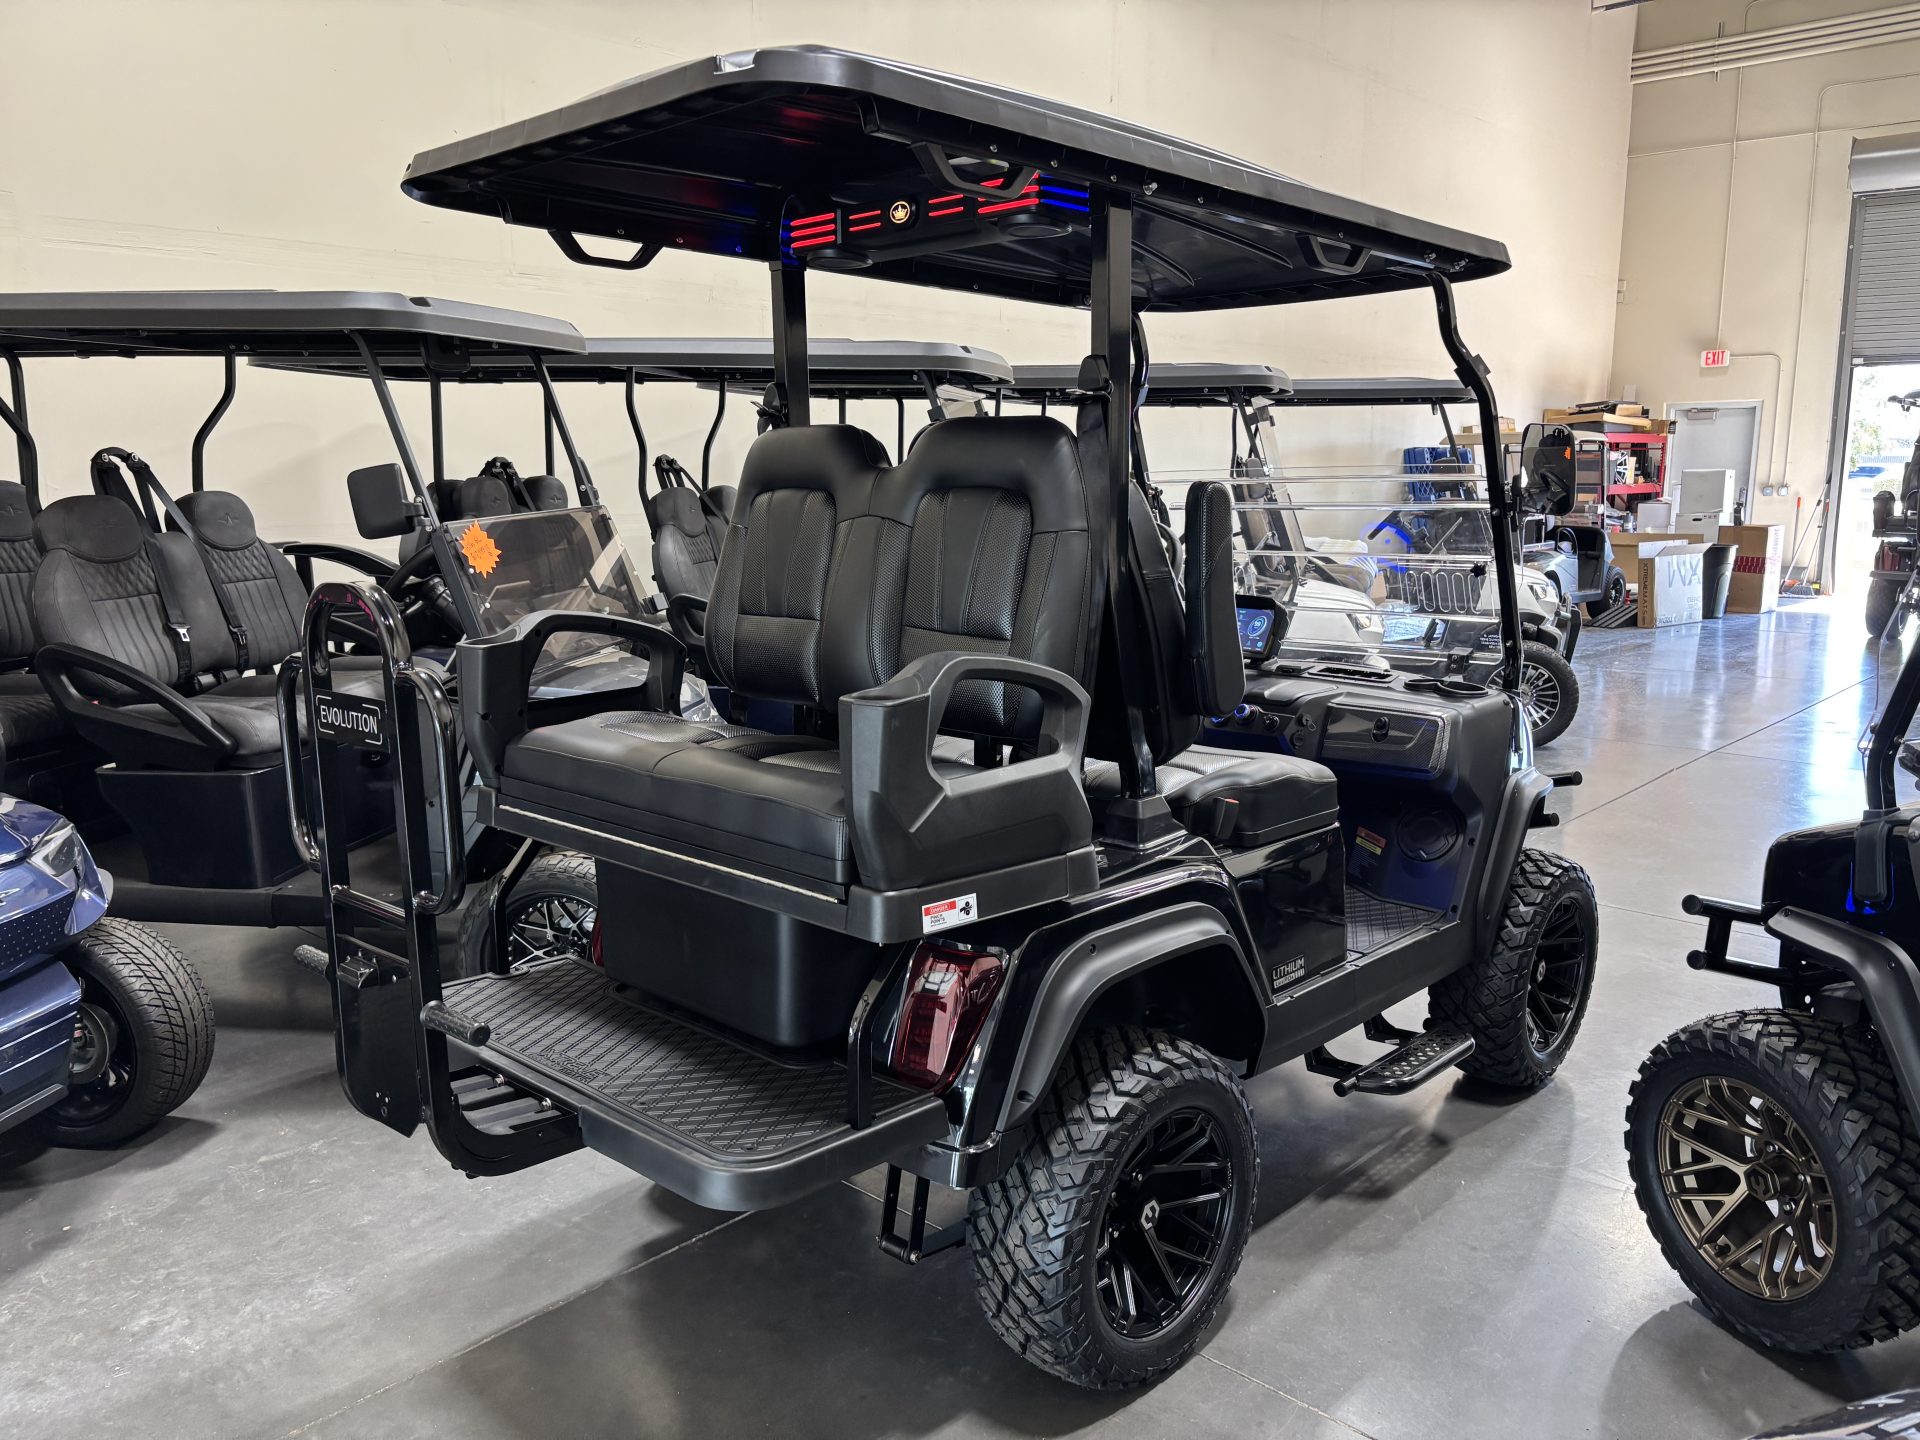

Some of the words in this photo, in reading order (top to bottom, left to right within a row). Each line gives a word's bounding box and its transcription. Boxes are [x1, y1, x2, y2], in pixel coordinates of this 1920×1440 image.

[1705, 351, 1725, 365] EXIT
[320, 705, 378, 734] EVOLUTION
[1272, 957, 1305, 980] LITHIUM
